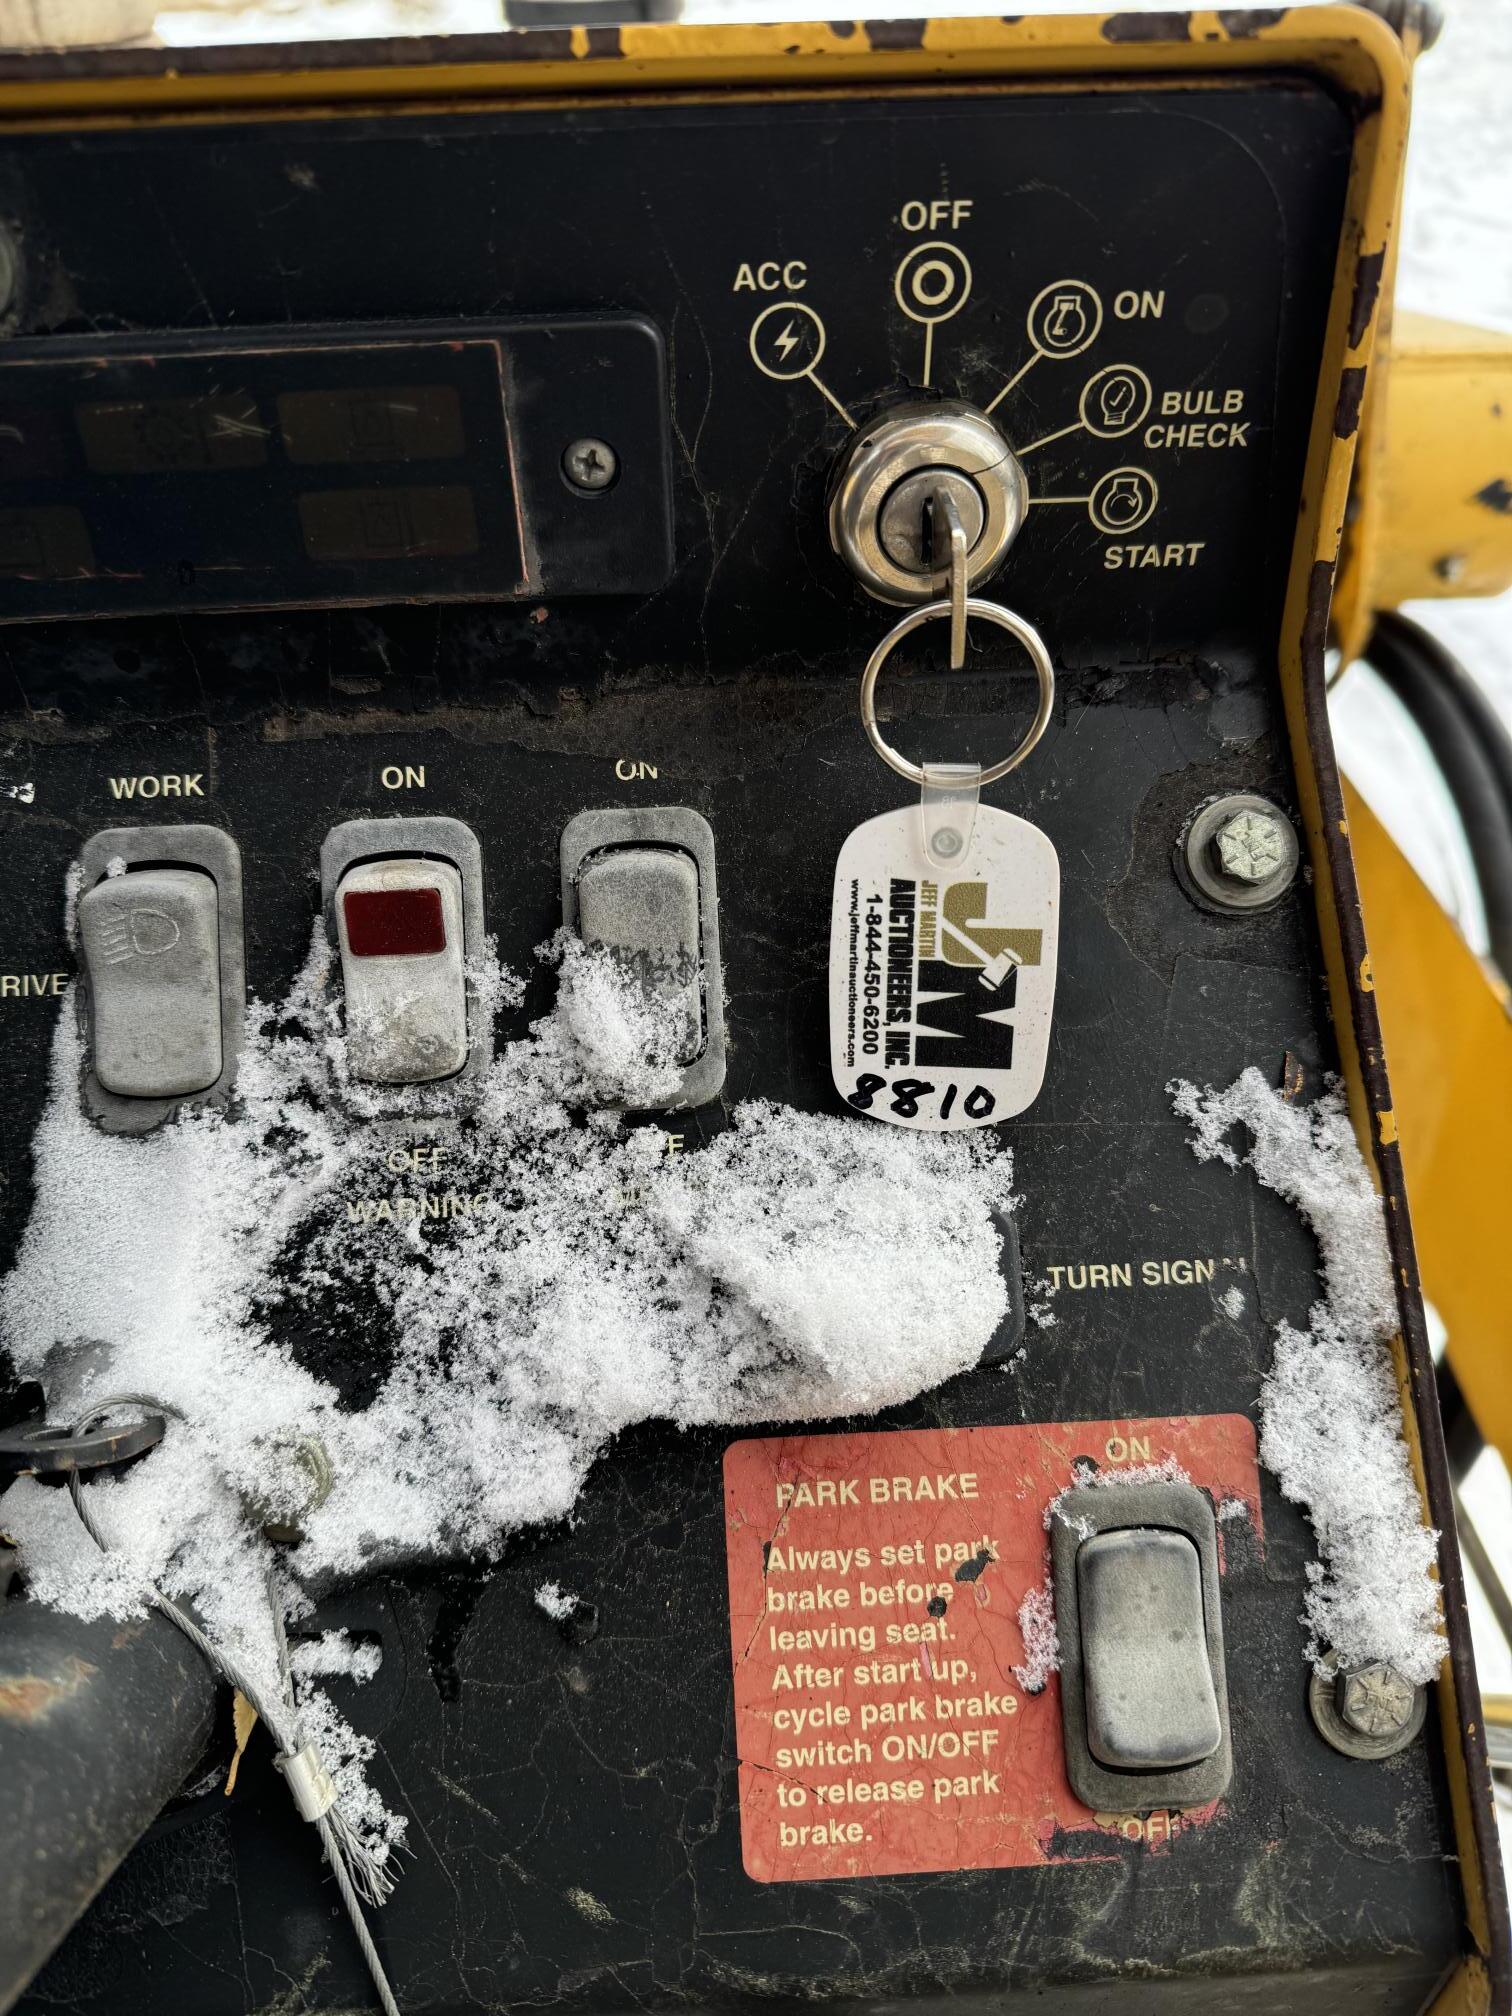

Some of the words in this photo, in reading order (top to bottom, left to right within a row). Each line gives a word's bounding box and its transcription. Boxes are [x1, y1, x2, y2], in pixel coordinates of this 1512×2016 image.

[900, 200, 973, 231] OFF
[733, 261, 808, 292] ACC
[1113, 290, 1165, 321] ON
[1160, 390, 1244, 416] BULB
[1144, 422, 1250, 449] CHECK
[1103, 542, 1205, 569] START
[381, 765, 426, 789] ON
[614, 759, 659, 781] ON
[110, 774, 205, 800] WORK
[921, 879, 938, 907] JEFF
[882, 878, 916, 1027] AUCTIONEERS,
[847, 878, 860, 1068] www.jeffmartinauctioneers.com
[862, 894, 883, 1055] 1-844-450-6200
[884, 1031, 911, 1070] INC.
[848, 1073, 996, 1119] 8810
[388, 1147, 448, 1174] OFF
[1046, 1263, 1132, 1290] TURN
[1142, 1258, 1247, 1286] SIGN
[1105, 1435, 1150, 1462] ON
[776, 1476, 860, 1508] PARK
[870, 1473, 979, 1504] BRAKE
[767, 1545, 870, 1577] Always
[880, 1541, 926, 1566] set
[934, 1534, 1000, 1571] park
[768, 1585, 850, 1612] brake
[860, 1580, 954, 1608] before
[769, 1624, 876, 1657] leaving
[886, 1617, 956, 1645] seat.
[773, 1662, 843, 1690] After
[853, 1658, 922, 1685] start
[932, 1660, 977, 1688] up,
[773, 1699, 851, 1735] cycle
[861, 1696, 926, 1727] park
[935, 1693, 1018, 1719] brake
[776, 1737, 872, 1768] switch
[881, 1730, 999, 1760] ON/OFF
[777, 1782, 807, 1807] to
[816, 1776, 924, 1805] release
[934, 1772, 1000, 1806] park
[780, 1819, 873, 1847] brake.
